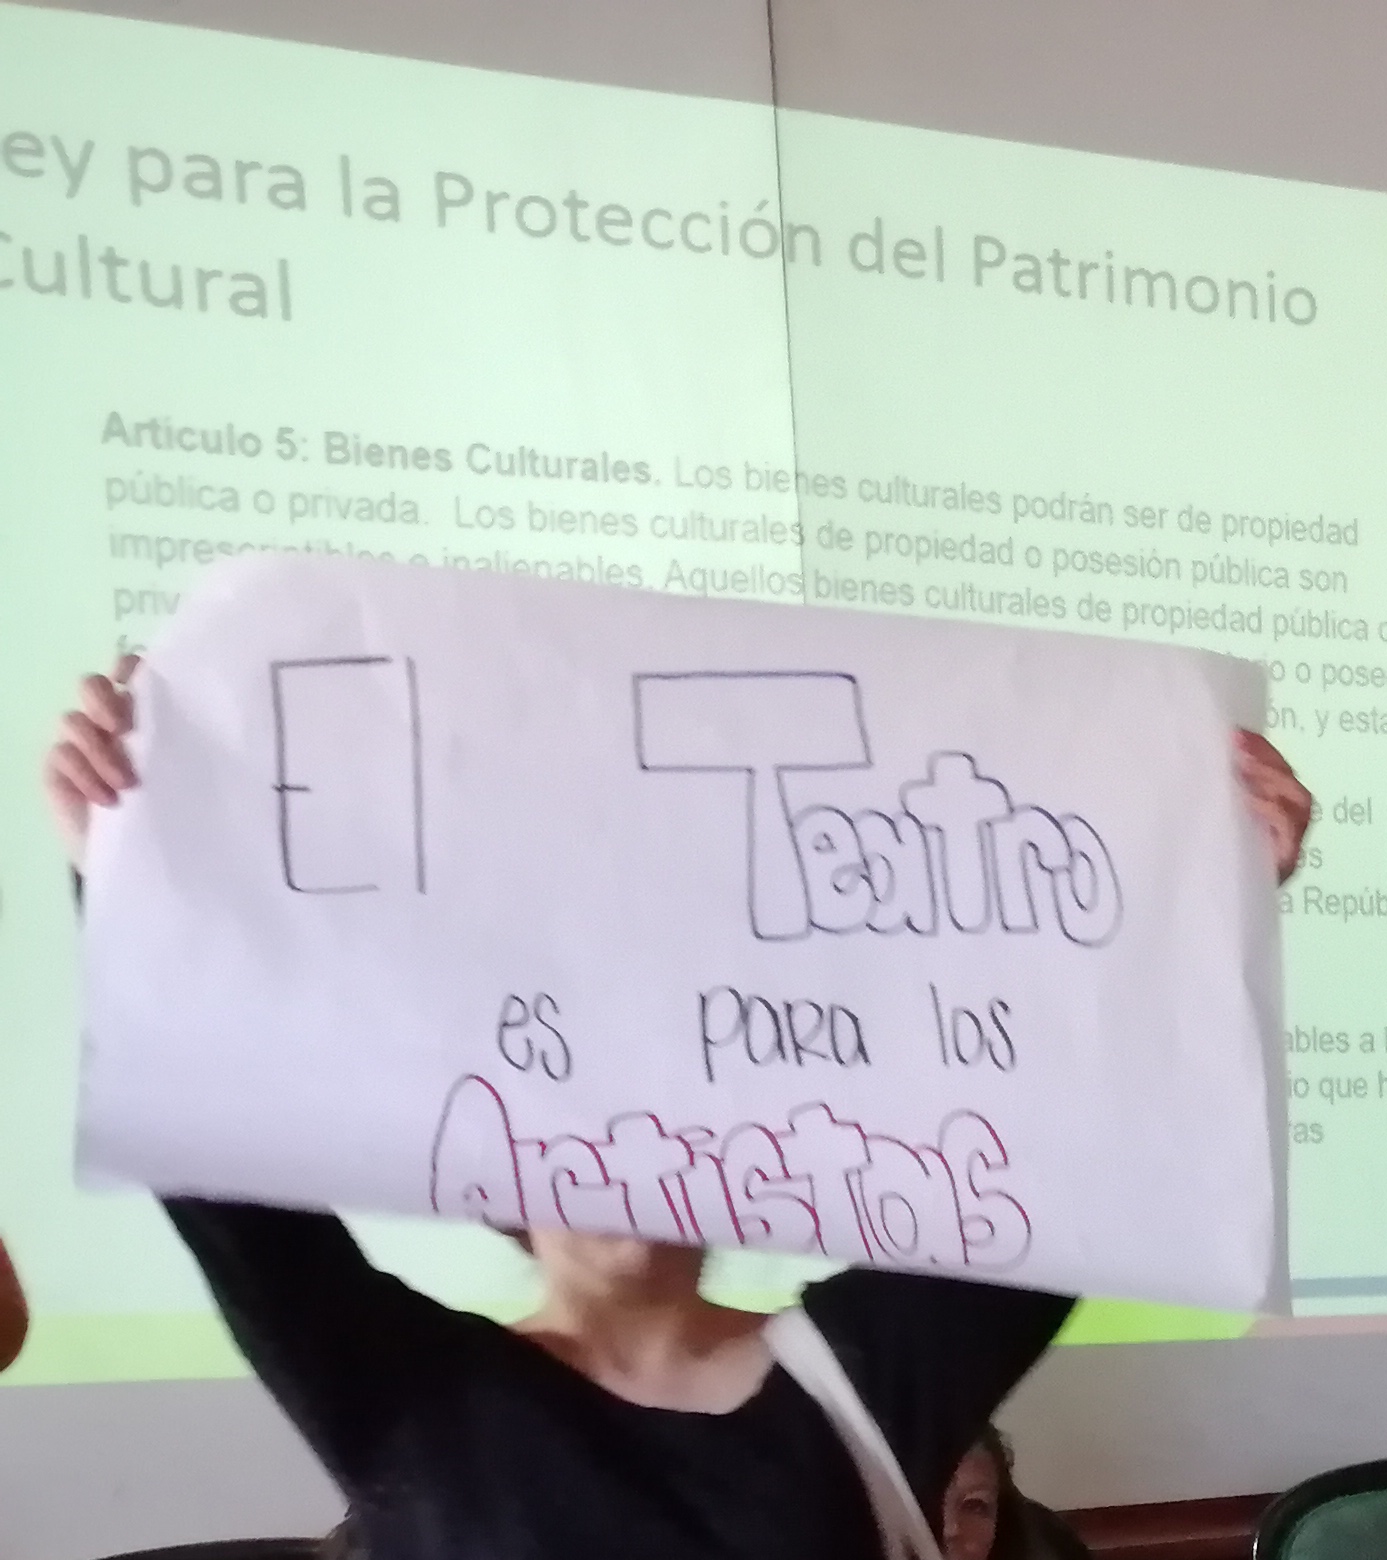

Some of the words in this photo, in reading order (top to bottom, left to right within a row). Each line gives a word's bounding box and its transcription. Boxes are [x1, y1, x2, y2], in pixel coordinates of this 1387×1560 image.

[126, 144, 308, 213] para
[338, 153, 402, 225] la
[434, 170, 823, 268] Protección
[848, 216, 946, 285] del
[972, 233, 1319, 327] Patrimonio
[275, 426, 309, 462] 5:
[324, 430, 453, 472] Bienes
[466, 441, 660, 486] Culturales.
[674, 456, 732, 489] Los
[745, 461, 847, 499] bienes
[857, 474, 1002, 515] culturales
[1012, 491, 1113, 526] podrán
[1123, 503, 1169, 530] ser
[1177, 504, 1212, 534] de
[1222, 512, 1360, 547] propiedad
[105, 469, 241, 512] pública
[252, 489, 276, 514] o
[288, 491, 429, 525] privada.
[455, 495, 516, 530] Los
[528, 500, 639, 537] bienes
[651, 511, 805, 548] culturales
[816, 520, 854, 551] de
[865, 529, 1013, 568] propiedad
[1024, 543, 1042, 569] o
[1053, 546, 1181, 580] posesión
[1192, 552, 1290, 590] pública
[1299, 565, 1348, 593] son
[665, 558, 804, 598] Aquellos
[814, 569, 915, 607] bienes
[925, 582, 1067, 621] culturales
[1077, 592, 1112, 624] de
[1122, 600, 1262, 635] propiedad
[1273, 606, 1369, 642] pública
[1295, 661, 1312, 684] o
[1315, 708, 1329, 738] y
[270, 655, 427, 896] El
[632, 669, 1125, 947] Teatro
[1332, 796, 1373, 826] del
[495, 989, 575, 1081] es
[698, 986, 872, 1084] para
[928, 981, 1020, 1075] los
[1359, 1031, 1376, 1053] a
[1318, 1077, 1368, 1106] que
